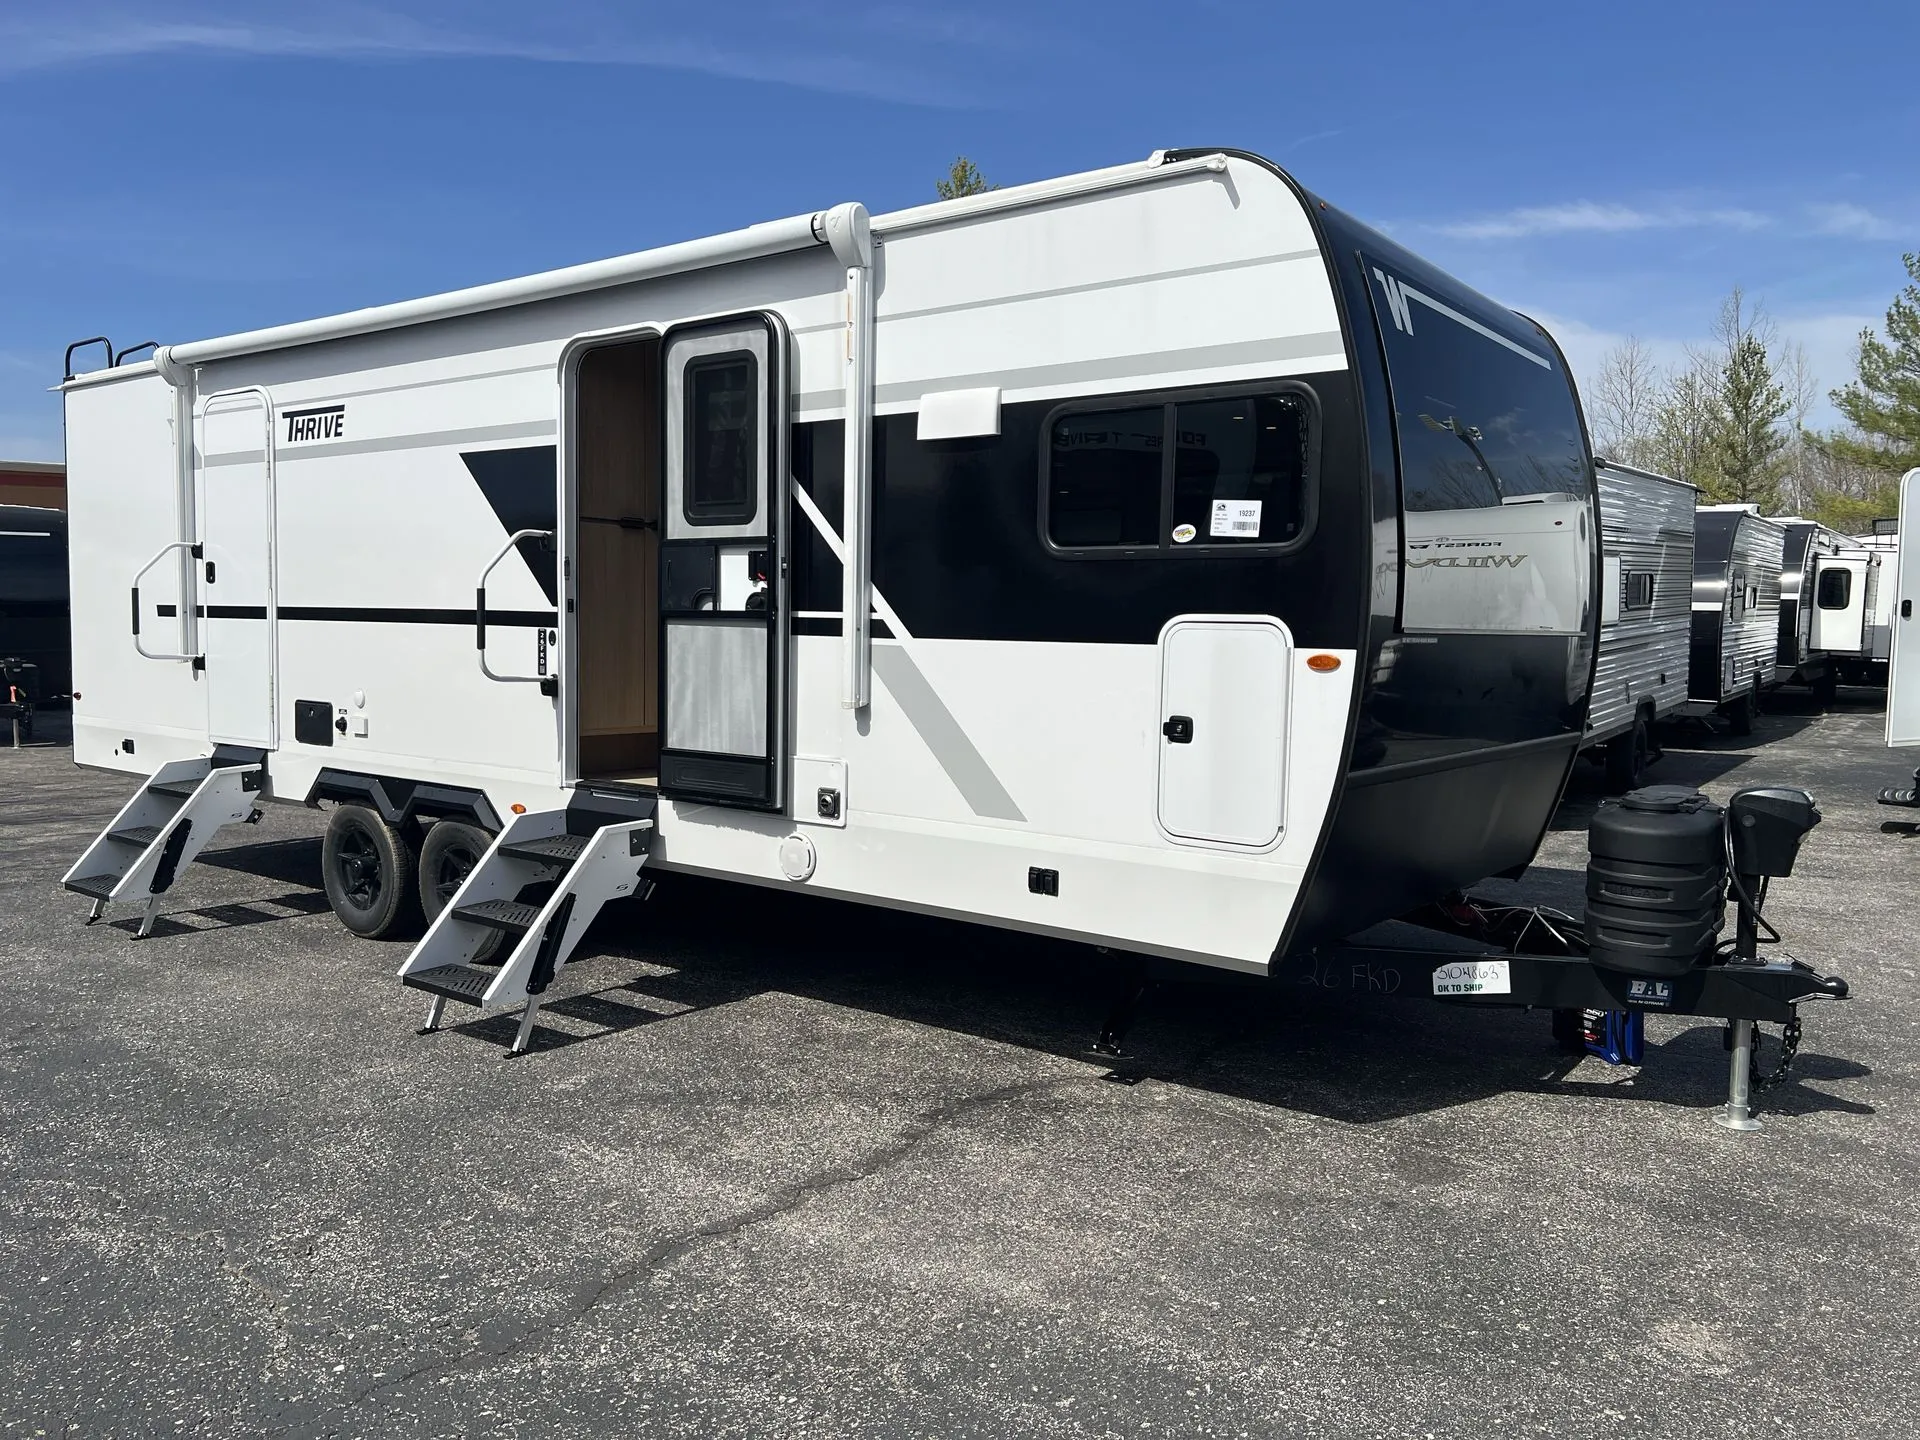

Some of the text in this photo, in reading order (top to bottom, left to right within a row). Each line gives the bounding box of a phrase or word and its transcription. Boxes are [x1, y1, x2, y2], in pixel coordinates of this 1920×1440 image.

[282, 404, 345, 442] THRIVE
[1437, 984, 1484, 993] OK TO SHIP
